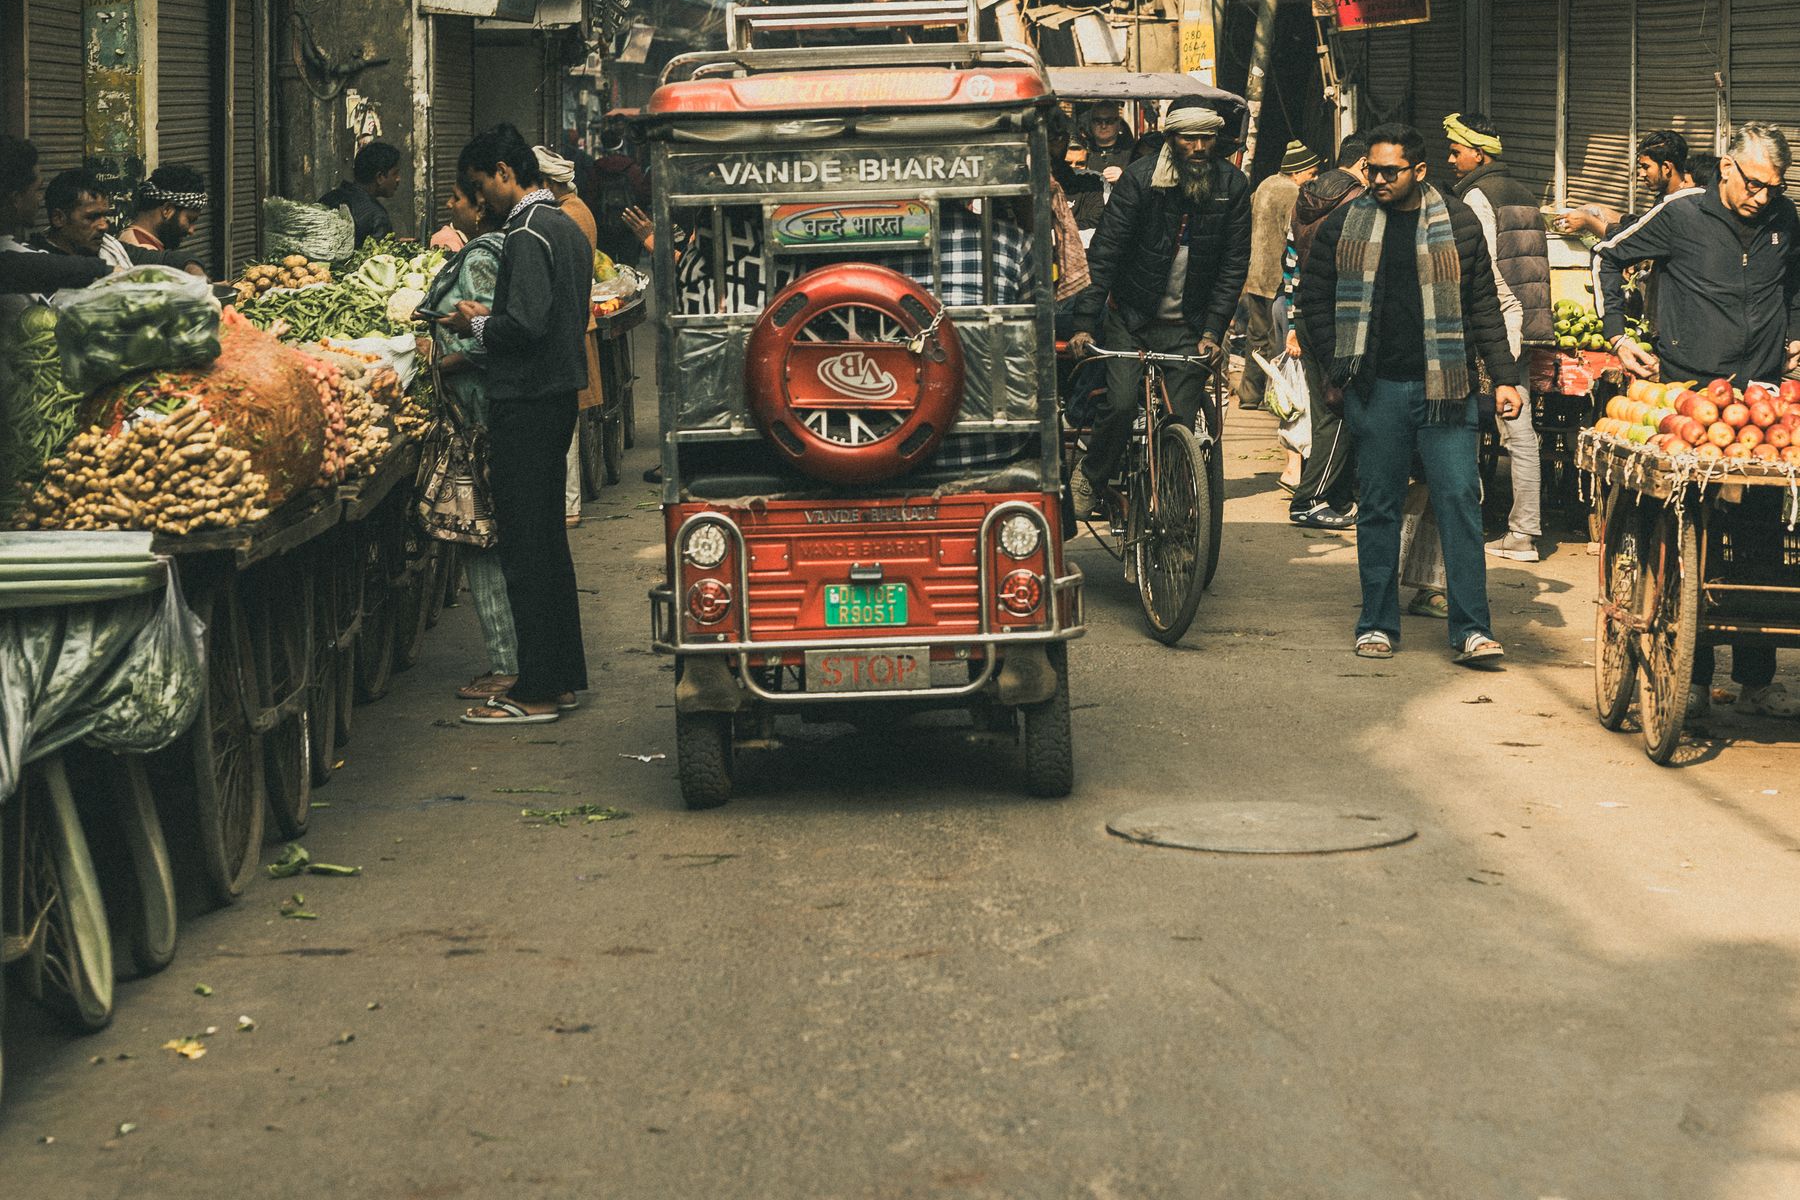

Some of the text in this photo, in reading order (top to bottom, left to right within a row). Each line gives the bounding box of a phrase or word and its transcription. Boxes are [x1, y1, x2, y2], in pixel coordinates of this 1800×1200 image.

[717, 155, 984, 185] VANDE BHARAT
[802, 210, 904, 238] वन्दे भारत
[804, 509, 859, 524] VANDE
[801, 540, 927, 556] VANDE BHARAT
[839, 606, 896, 623] R9051
[821, 655, 917, 686] STOP
